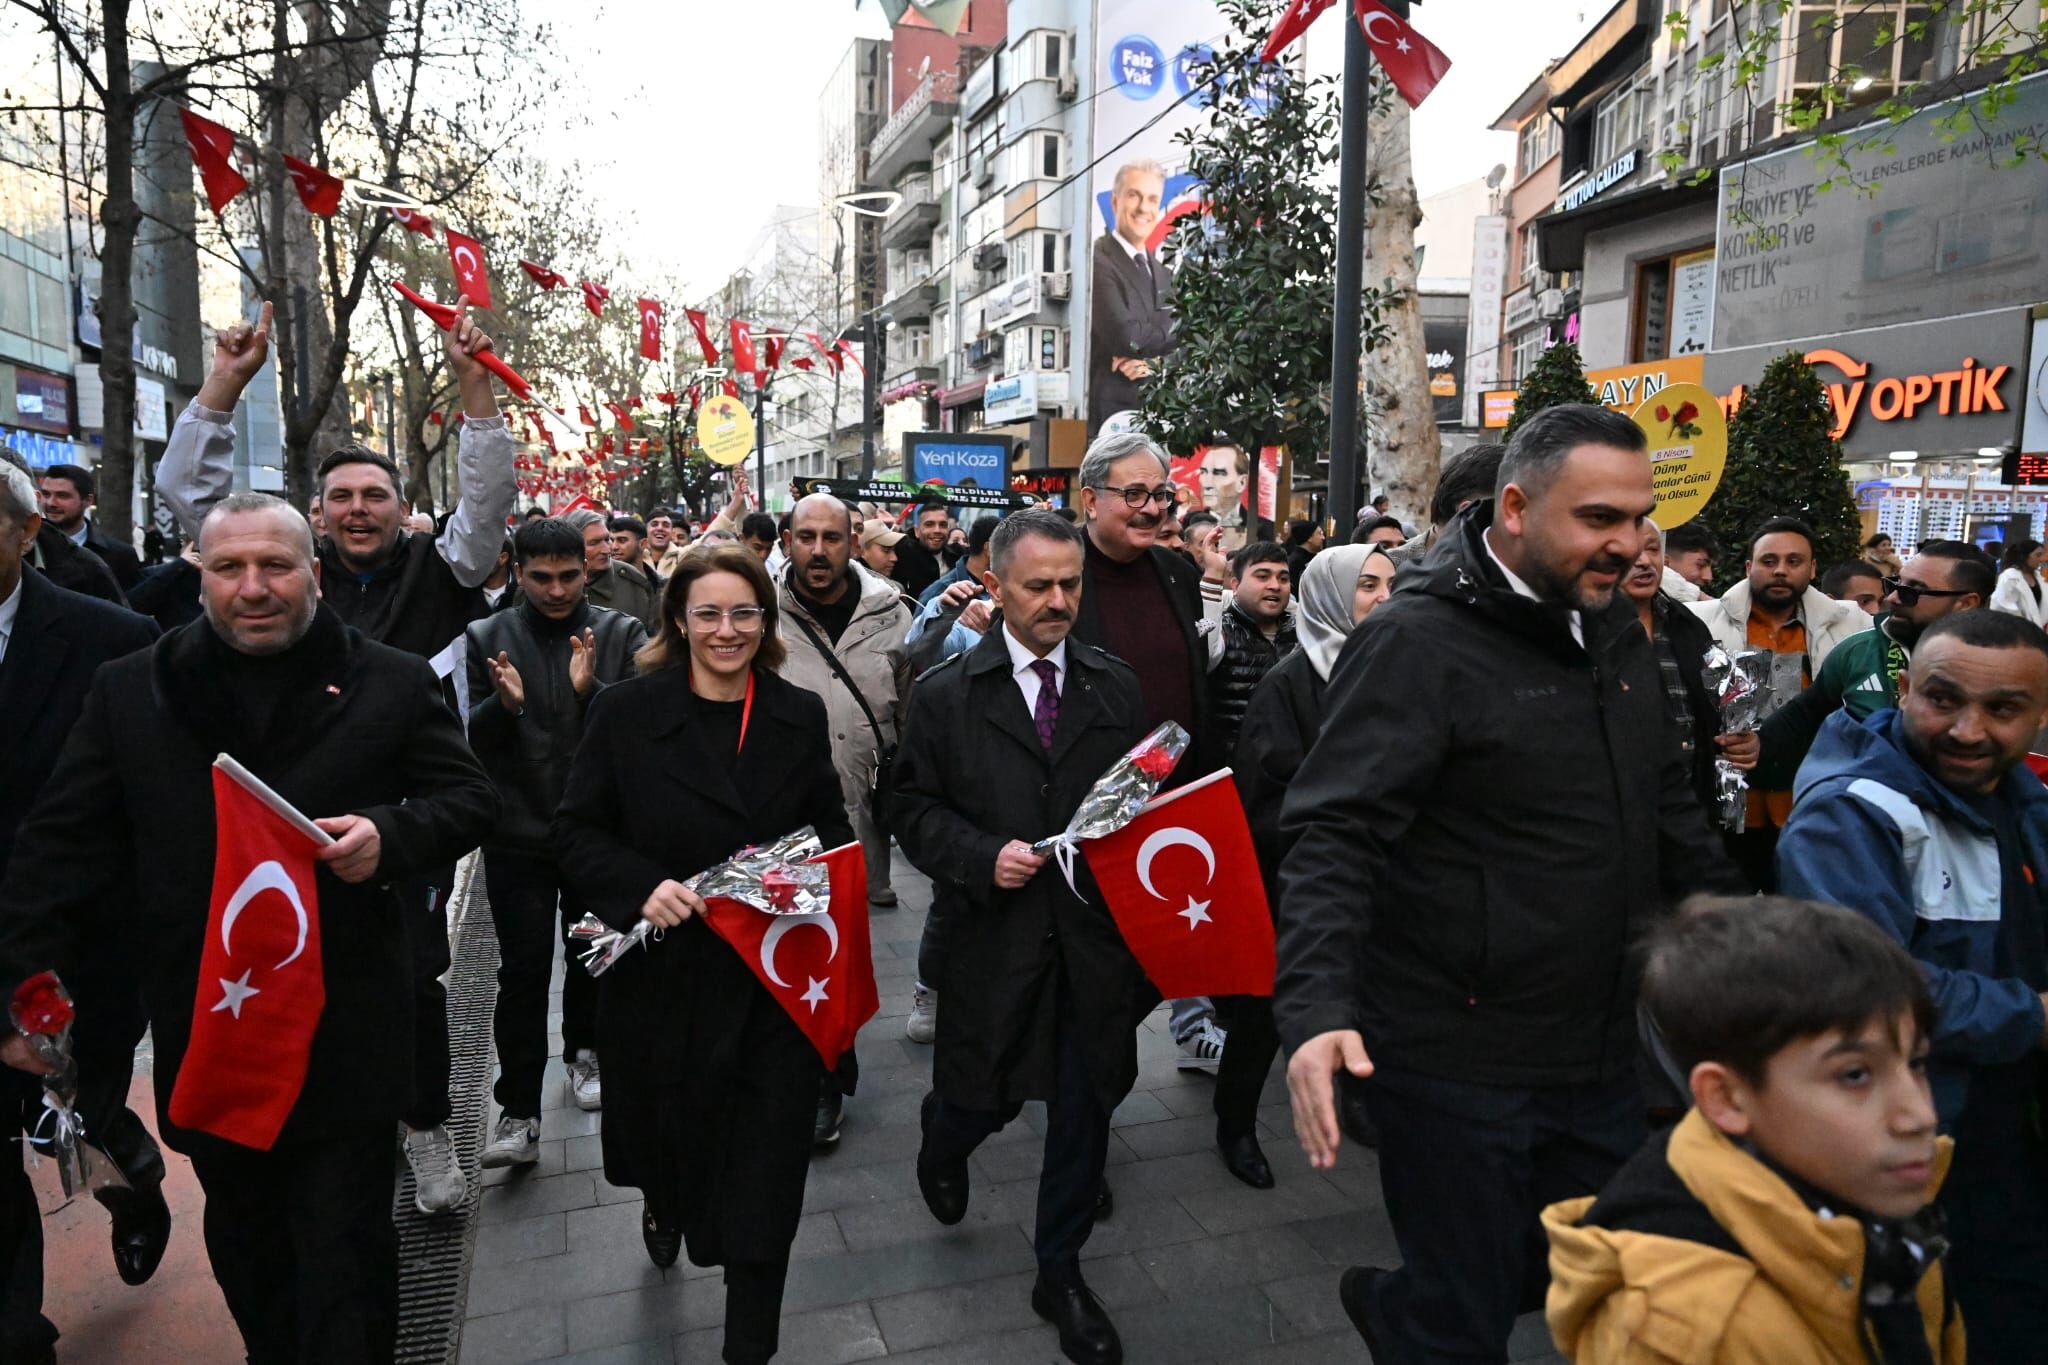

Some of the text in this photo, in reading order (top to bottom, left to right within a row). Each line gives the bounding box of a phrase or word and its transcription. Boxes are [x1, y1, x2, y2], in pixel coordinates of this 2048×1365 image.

[1122, 49, 1153, 68] Faiz
[1123, 68, 1153, 85] Yok
[1566, 149, 1636, 211] TATTOO GALLERY
[1794, 223, 1815, 246] ve
[1870, 356, 2010, 422] OPTİK
[1655, 448, 1689, 459] 8 Nisan
[1653, 463, 1687, 475] Dünya
[1653, 471, 1711, 489] anlar Günü
[869, 482, 1002, 497] GERİ GELDİLER
[1667, 488, 1699, 501] Olsun.
